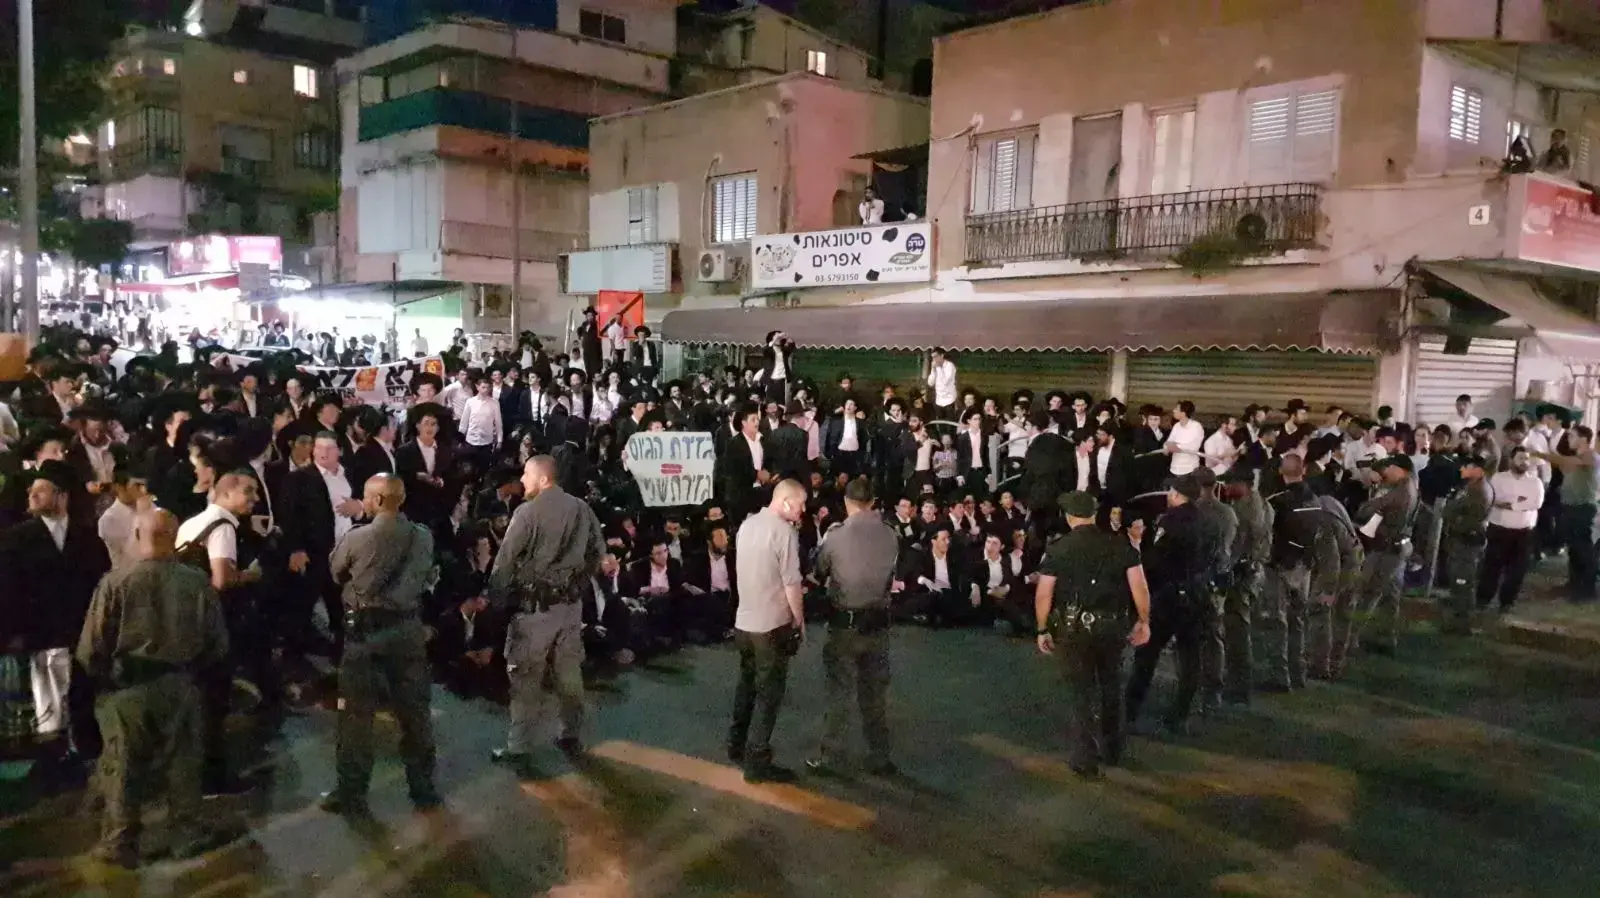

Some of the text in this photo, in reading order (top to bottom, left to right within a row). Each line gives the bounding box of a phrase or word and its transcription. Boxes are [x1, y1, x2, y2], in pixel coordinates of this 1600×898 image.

[1474, 208, 1483, 221] 4
[802, 231, 872, 249] סיטונאות
[812, 252, 861, 268] אפרים
[629, 436, 663, 461] הגיוס
